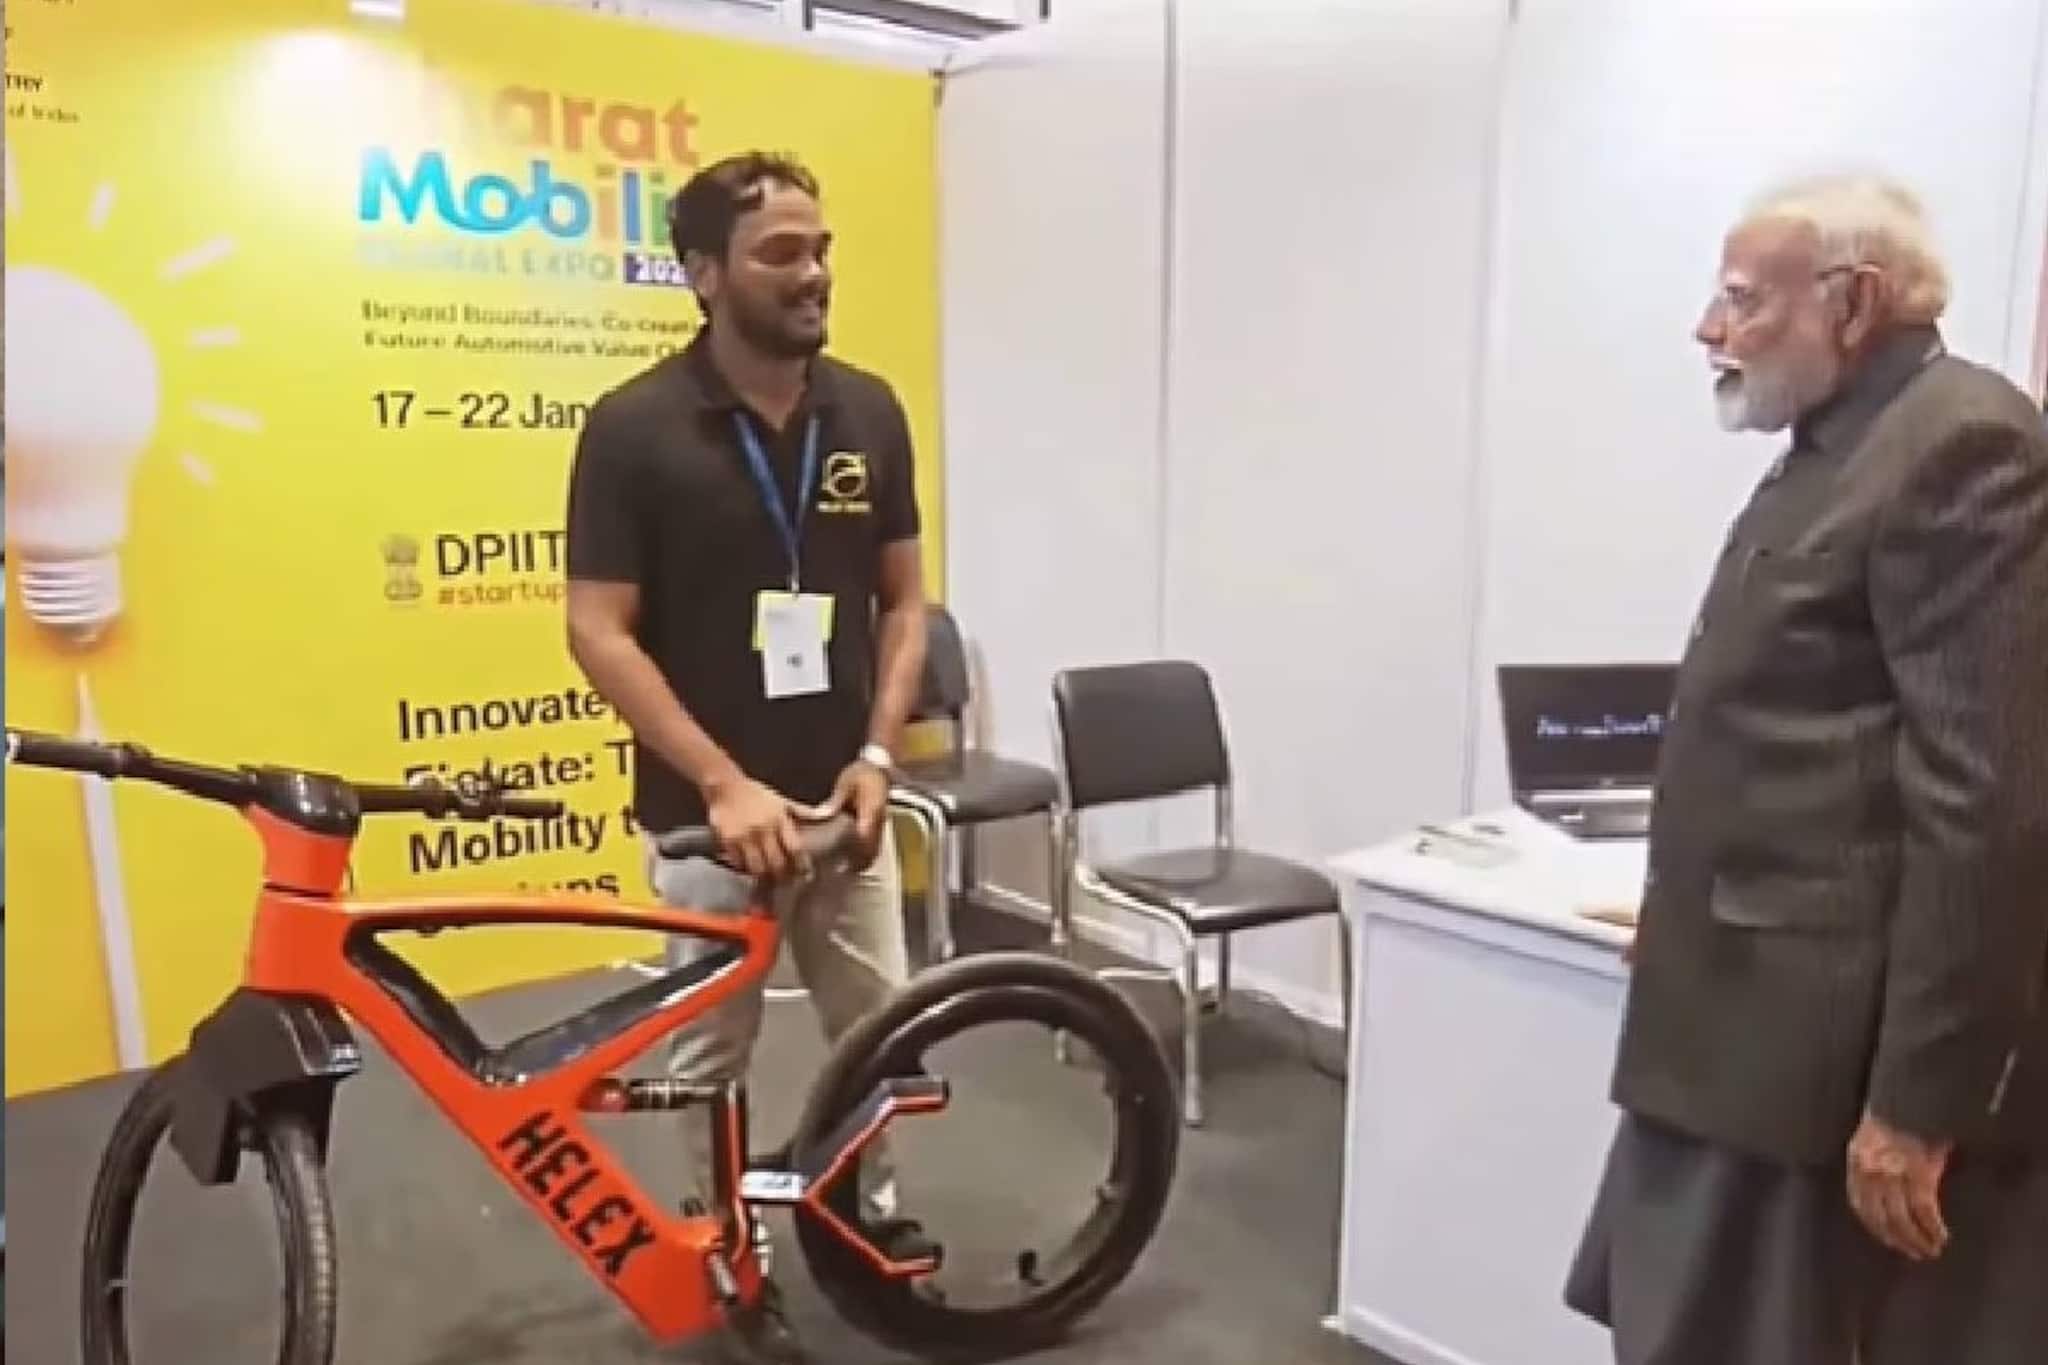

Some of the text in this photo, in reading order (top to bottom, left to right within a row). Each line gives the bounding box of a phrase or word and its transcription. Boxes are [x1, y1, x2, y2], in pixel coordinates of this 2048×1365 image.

[492, 86, 699, 166] arat
[362, 300, 457, 324] Beyond
[364, 332, 446, 348] Future
[454, 333, 586, 353] Automotive
[373, 391, 416, 429] 17
[460, 392, 511, 429] 22
[437, 532, 567, 577] DPIIT
[409, 810, 606, 874] Mobility
[498, 1110, 655, 1276] HELEX
